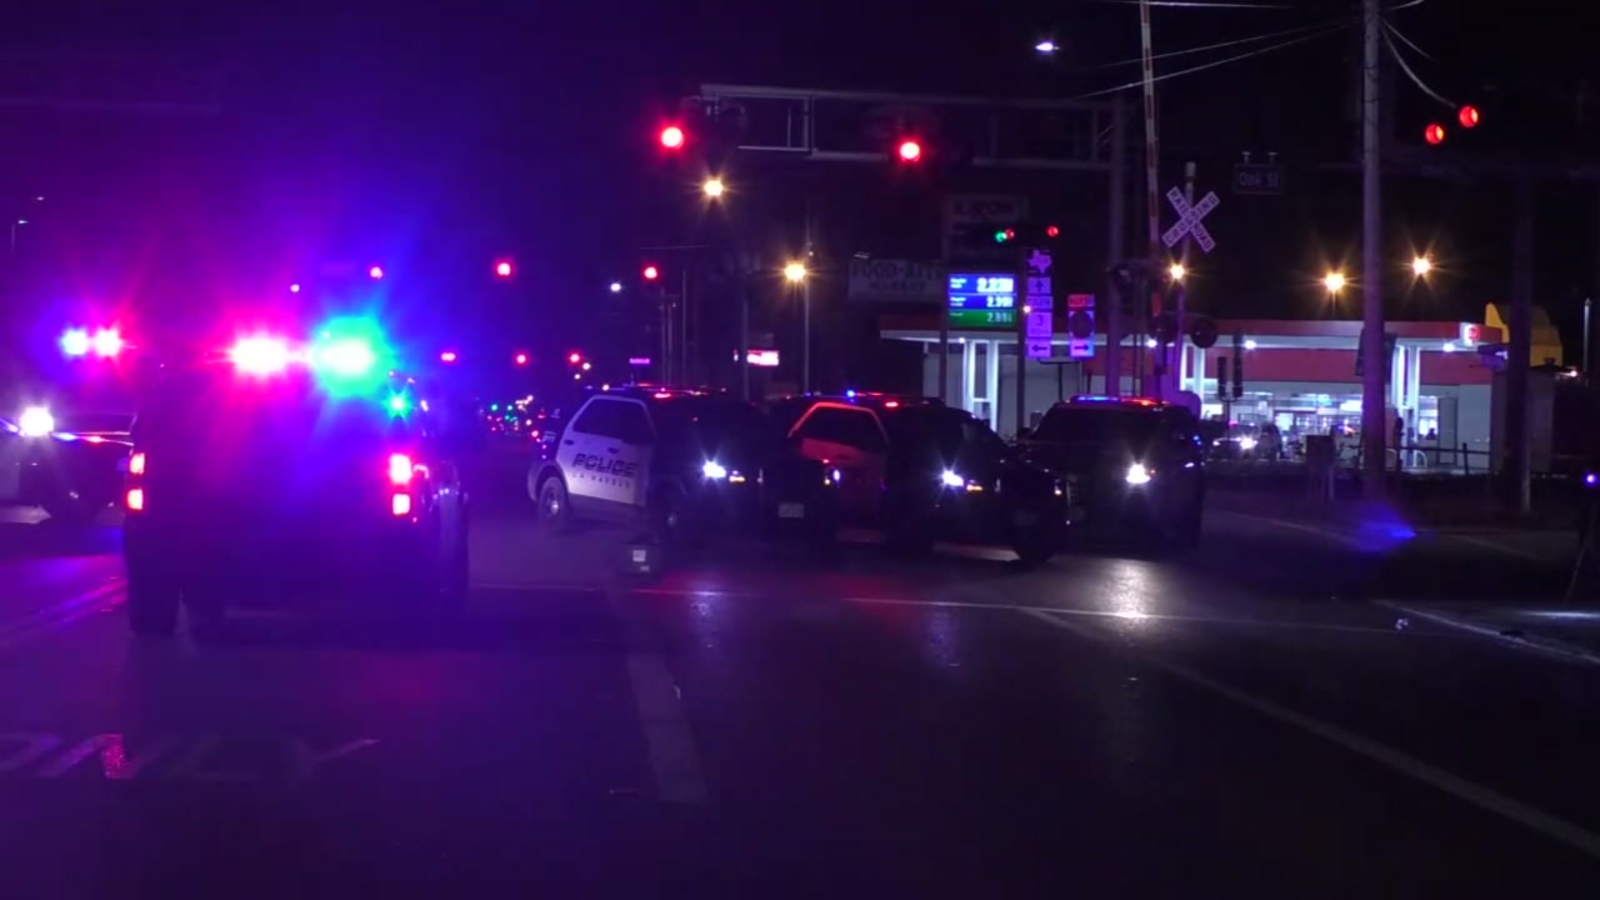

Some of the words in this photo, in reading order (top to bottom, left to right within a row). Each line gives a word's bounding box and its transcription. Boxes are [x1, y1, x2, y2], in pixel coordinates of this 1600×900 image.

[1239, 171, 1261, 186] Oak
[1164, 195, 1217, 244] CROSSING
[573, 453, 639, 477] POLICE
